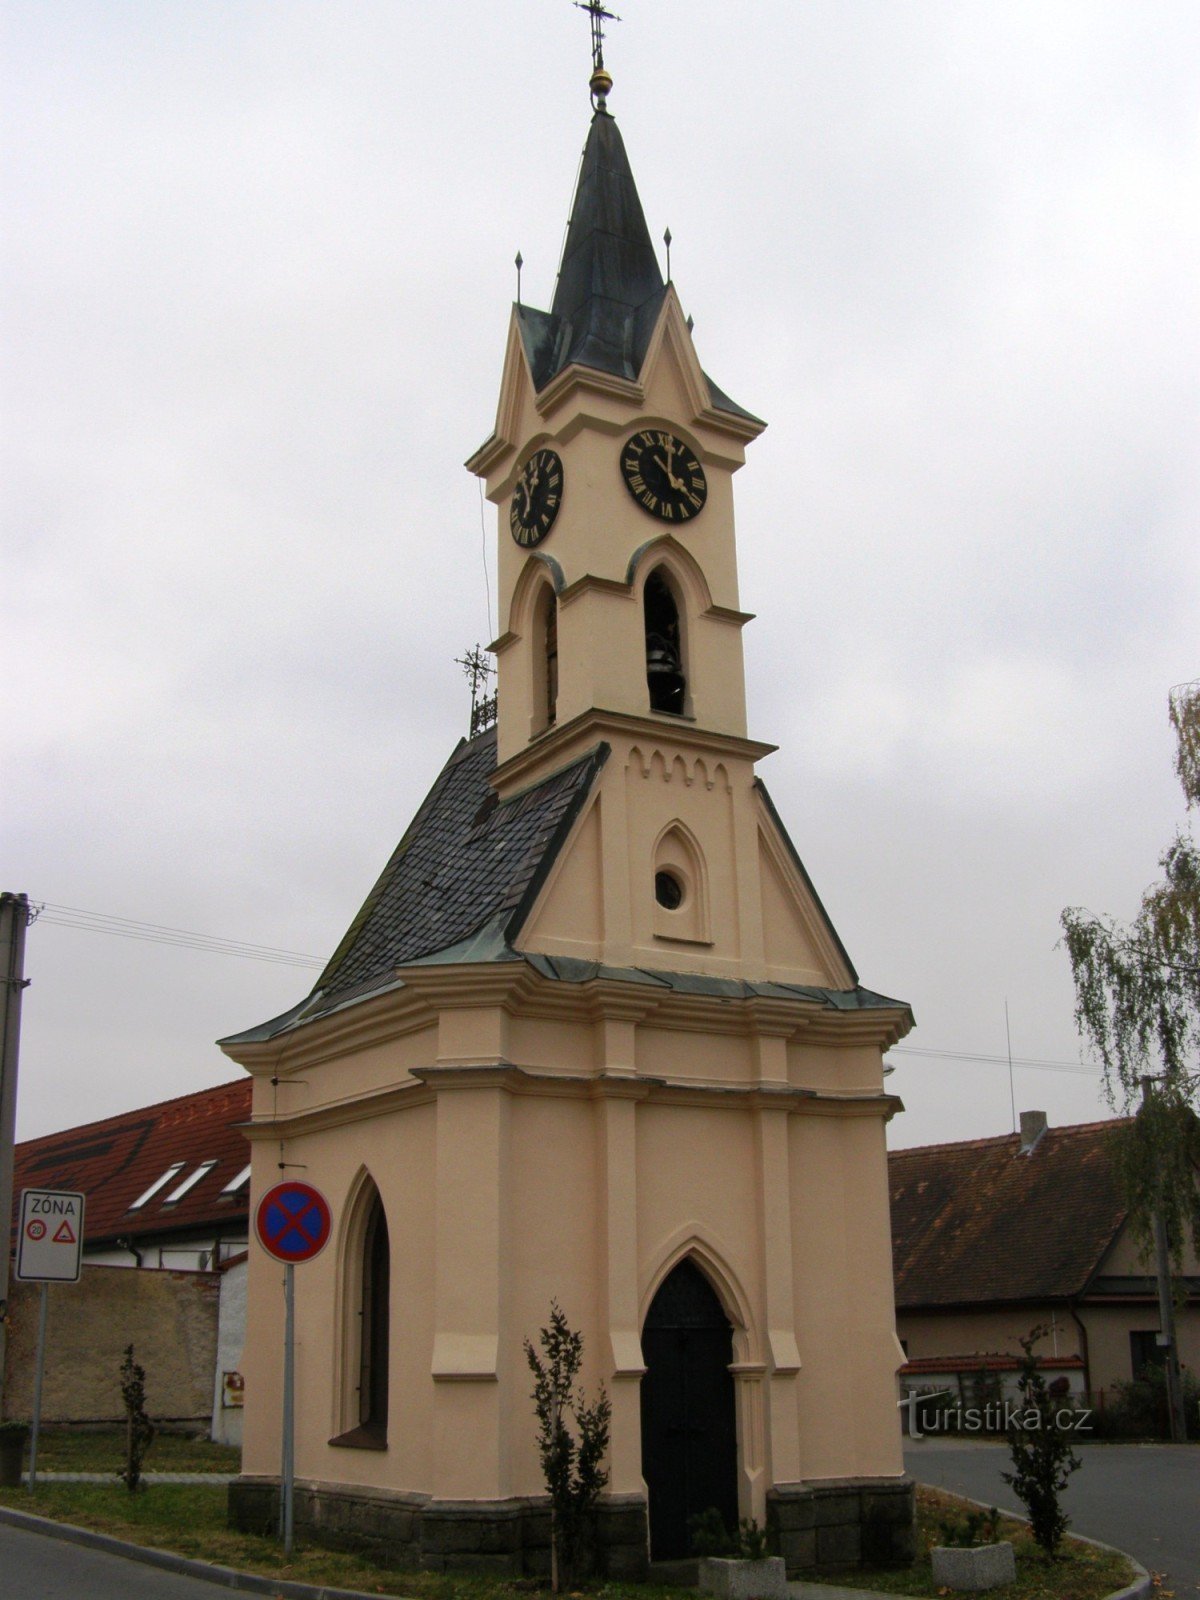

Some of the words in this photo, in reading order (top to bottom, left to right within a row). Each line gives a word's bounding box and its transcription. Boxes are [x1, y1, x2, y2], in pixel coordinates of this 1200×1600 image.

[641, 432, 655, 447] XI
[629, 441, 643, 456] X
[677, 445, 685, 456] I
[625, 458, 640, 472] IX
[687, 461, 699, 471] II
[628, 474, 646, 495] VIII
[692, 477, 705, 490] III
[642, 491, 658, 510] VII
[688, 492, 703, 510] IV
[662, 502, 673, 518] VI
[679, 503, 689, 518] V
[31, 1196, 75, 1215] ZÓNA
